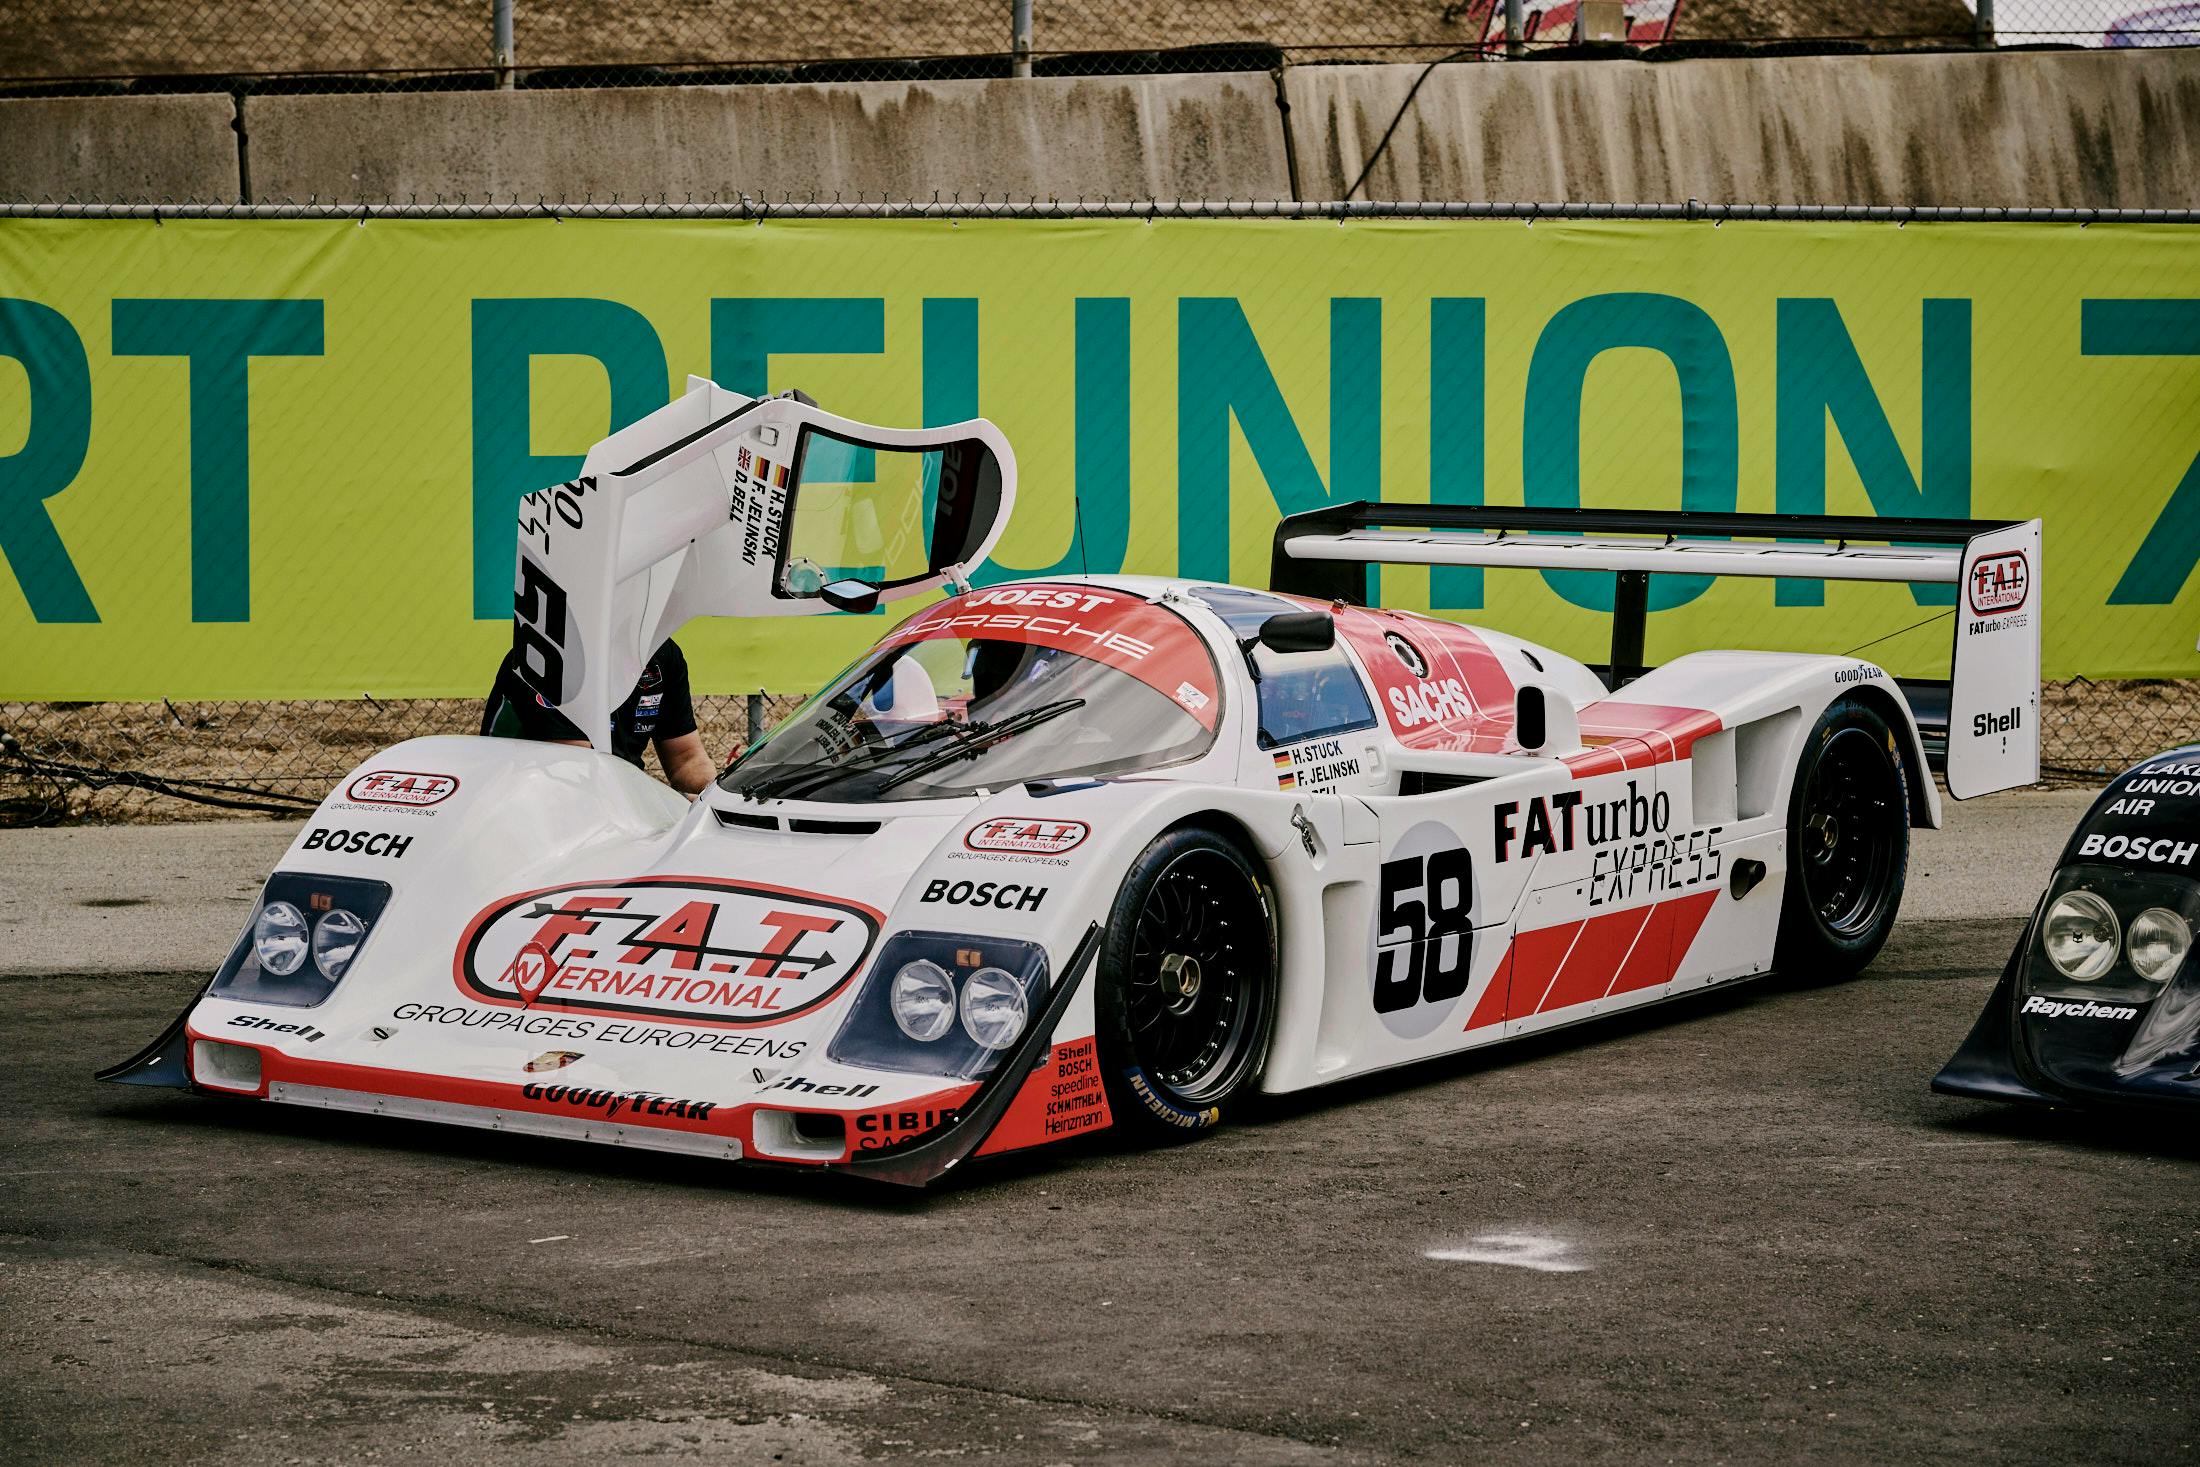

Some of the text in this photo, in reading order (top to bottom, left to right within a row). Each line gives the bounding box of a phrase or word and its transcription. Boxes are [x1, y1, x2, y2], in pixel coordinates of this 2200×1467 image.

[964, 589, 1116, 614] JOEST
[1976, 591, 2022, 607] INTERNATIONAL
[876, 613, 1155, 660] PORSCHE
[1834, 664, 1883, 683] GOODYEAR
[1388, 678, 1473, 727] SACHS
[1973, 707, 2021, 737] Shell
[1310, 758, 1360, 784] JELINSKI
[330, 803, 438, 817] GROUPAGES EUROPEENS
[357, 791, 432, 803] INTERNATIONAL
[2104, 799, 2156, 816] AIR
[302, 828, 414, 858] BOSCH
[976, 839, 1062, 851] INTERNATIONAL
[2078, 833, 2199, 866] BOSCH
[947, 852, 1070, 867] GROUPAGES EUROPEENS
[920, 879, 1048, 912] BOSCH
[1373, 847, 1473, 1015] 58
[498, 958, 782, 1010] INERNATIONAL
[2021, 996, 2137, 1020] Raychem
[227, 1015, 325, 1043] Shell
[393, 1003, 808, 1060] GROUPAGES EUROPEENS
[1058, 1043, 1092, 1061] Shell
[1058, 1058, 1092, 1078] BOSCH
[1051, 1074, 1099, 1098] speedline
[523, 1081, 718, 1121] GOODYEAR
[1046, 1091, 1103, 1116] SCHMITTHELM
[1129, 1074, 1197, 1128] MICHELIN
[1045, 1110, 1103, 1136] Heinzmann
